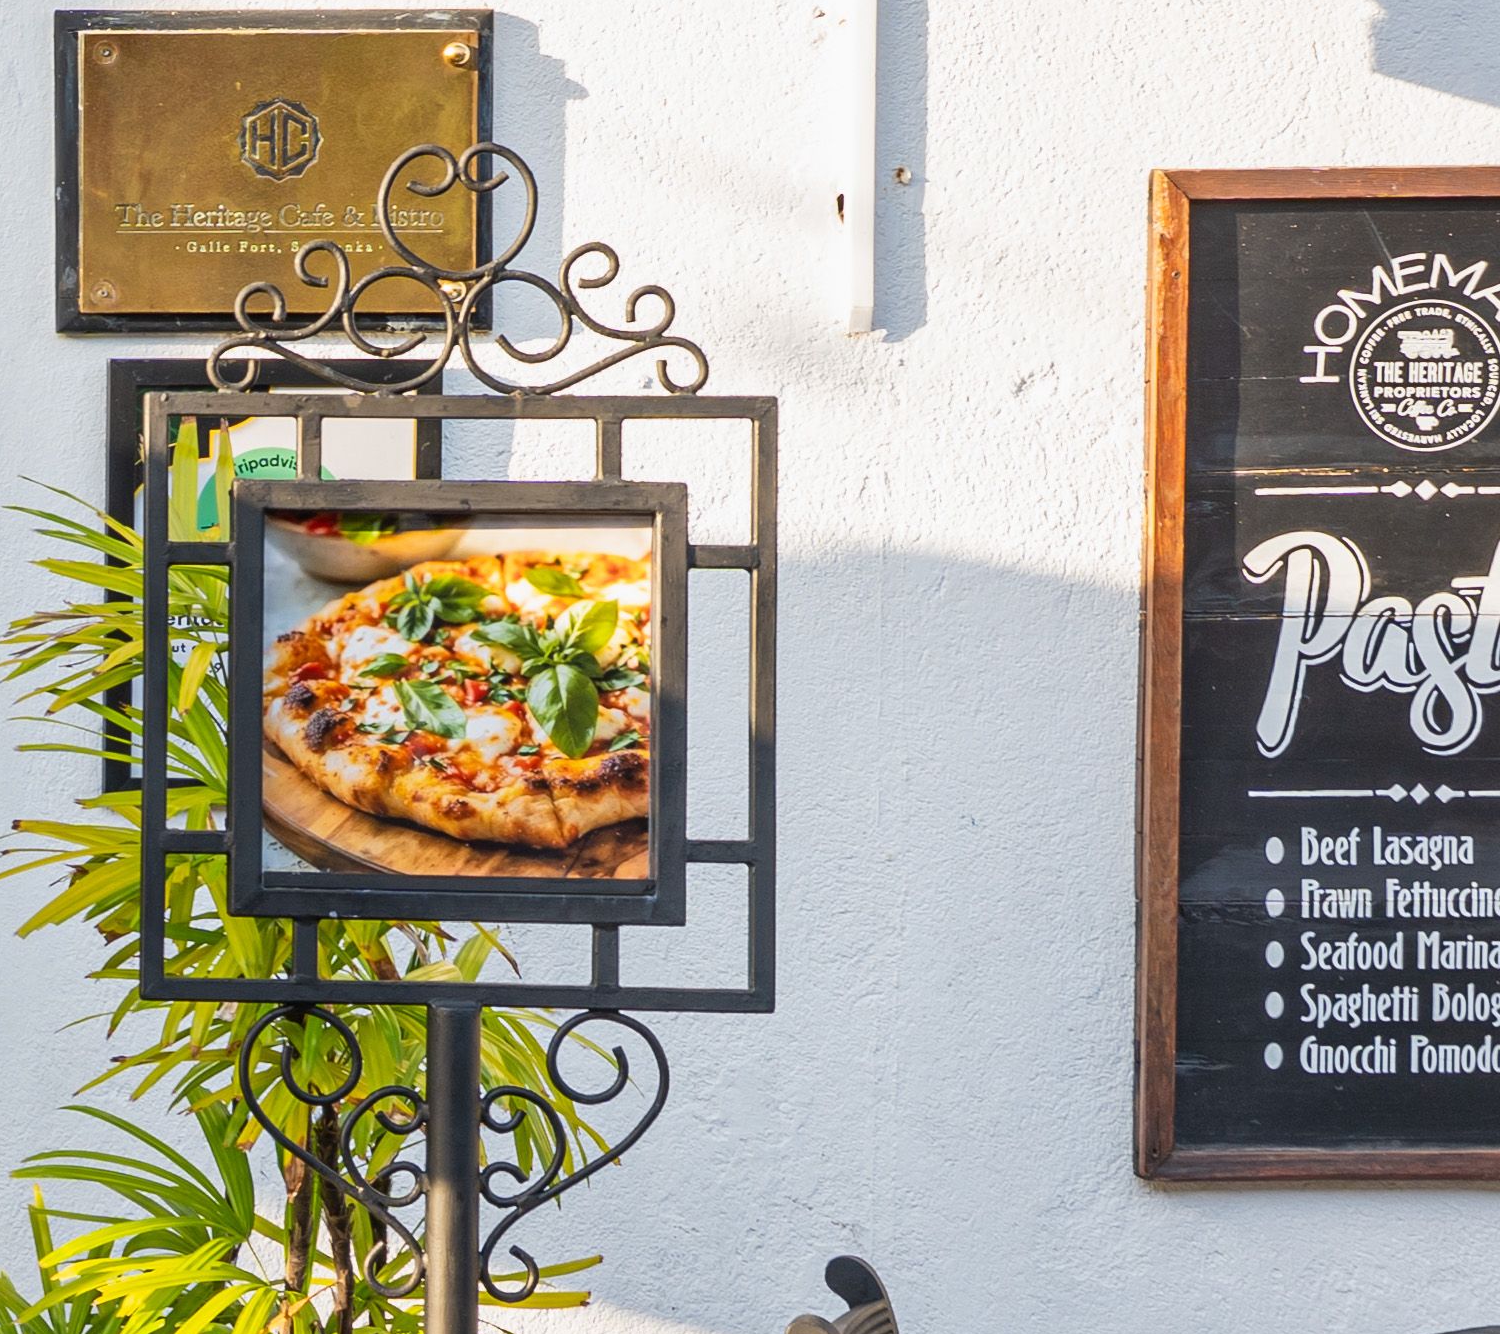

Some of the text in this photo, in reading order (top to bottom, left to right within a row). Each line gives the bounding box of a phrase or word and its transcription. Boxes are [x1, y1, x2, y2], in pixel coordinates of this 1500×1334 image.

[115, 204, 164, 227] The
[169, 204, 272, 232] Heritage
[279, 203, 335, 227] Cafe
[343, 205, 365, 227] &
[186, 242, 230, 253] Galle
[239, 242, 282, 254] Fort,
[1373, 362, 1483, 383] THE HERITAGE
[1374, 387, 1481, 398] PROPRIETORS
[235, 455, 297, 476] ripadvi
[1300, 826, 1475, 871] Beef Lasagna
[1300, 878, 1373, 919] Prawn
[1300, 931, 1404, 971] Seafood
[1300, 983, 1419, 1029] Spaghetti
[1300, 1035, 1397, 1075] Gnocchi
